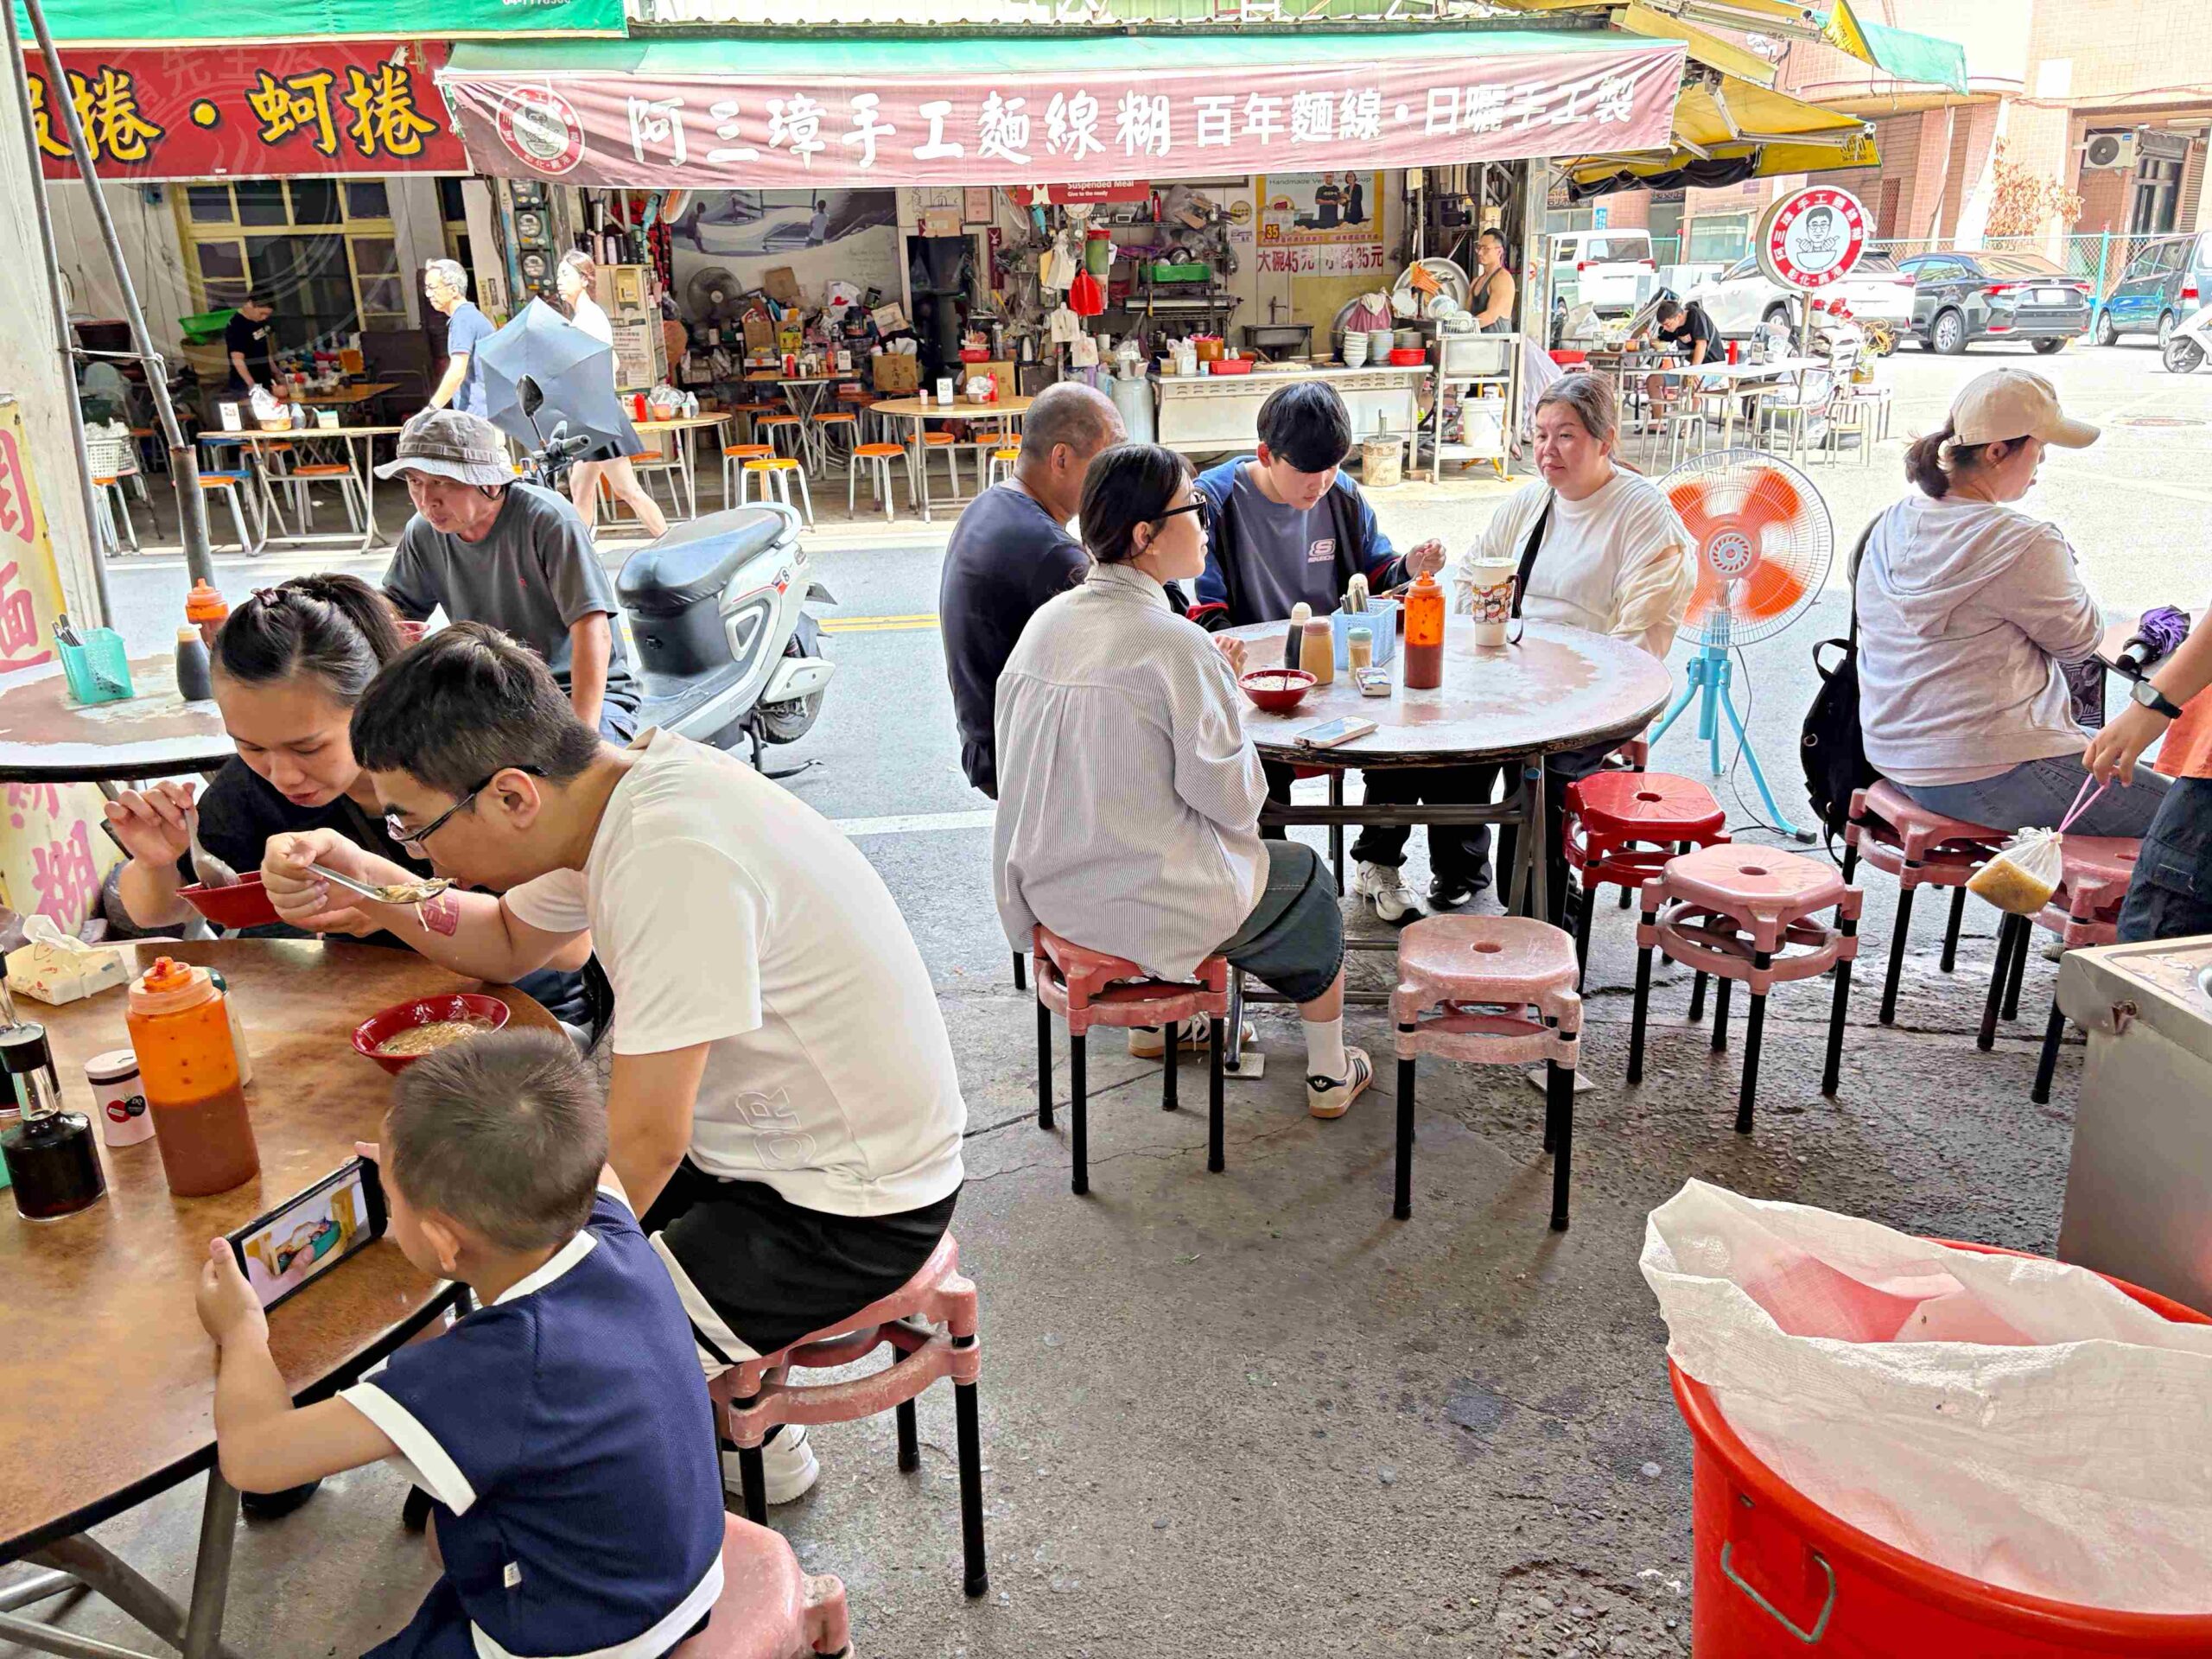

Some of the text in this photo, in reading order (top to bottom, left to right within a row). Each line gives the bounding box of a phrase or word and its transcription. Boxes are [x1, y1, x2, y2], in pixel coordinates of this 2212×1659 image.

[1067, 180, 1135, 191] Suspended Meal
[1266, 225, 1279, 238] 35
